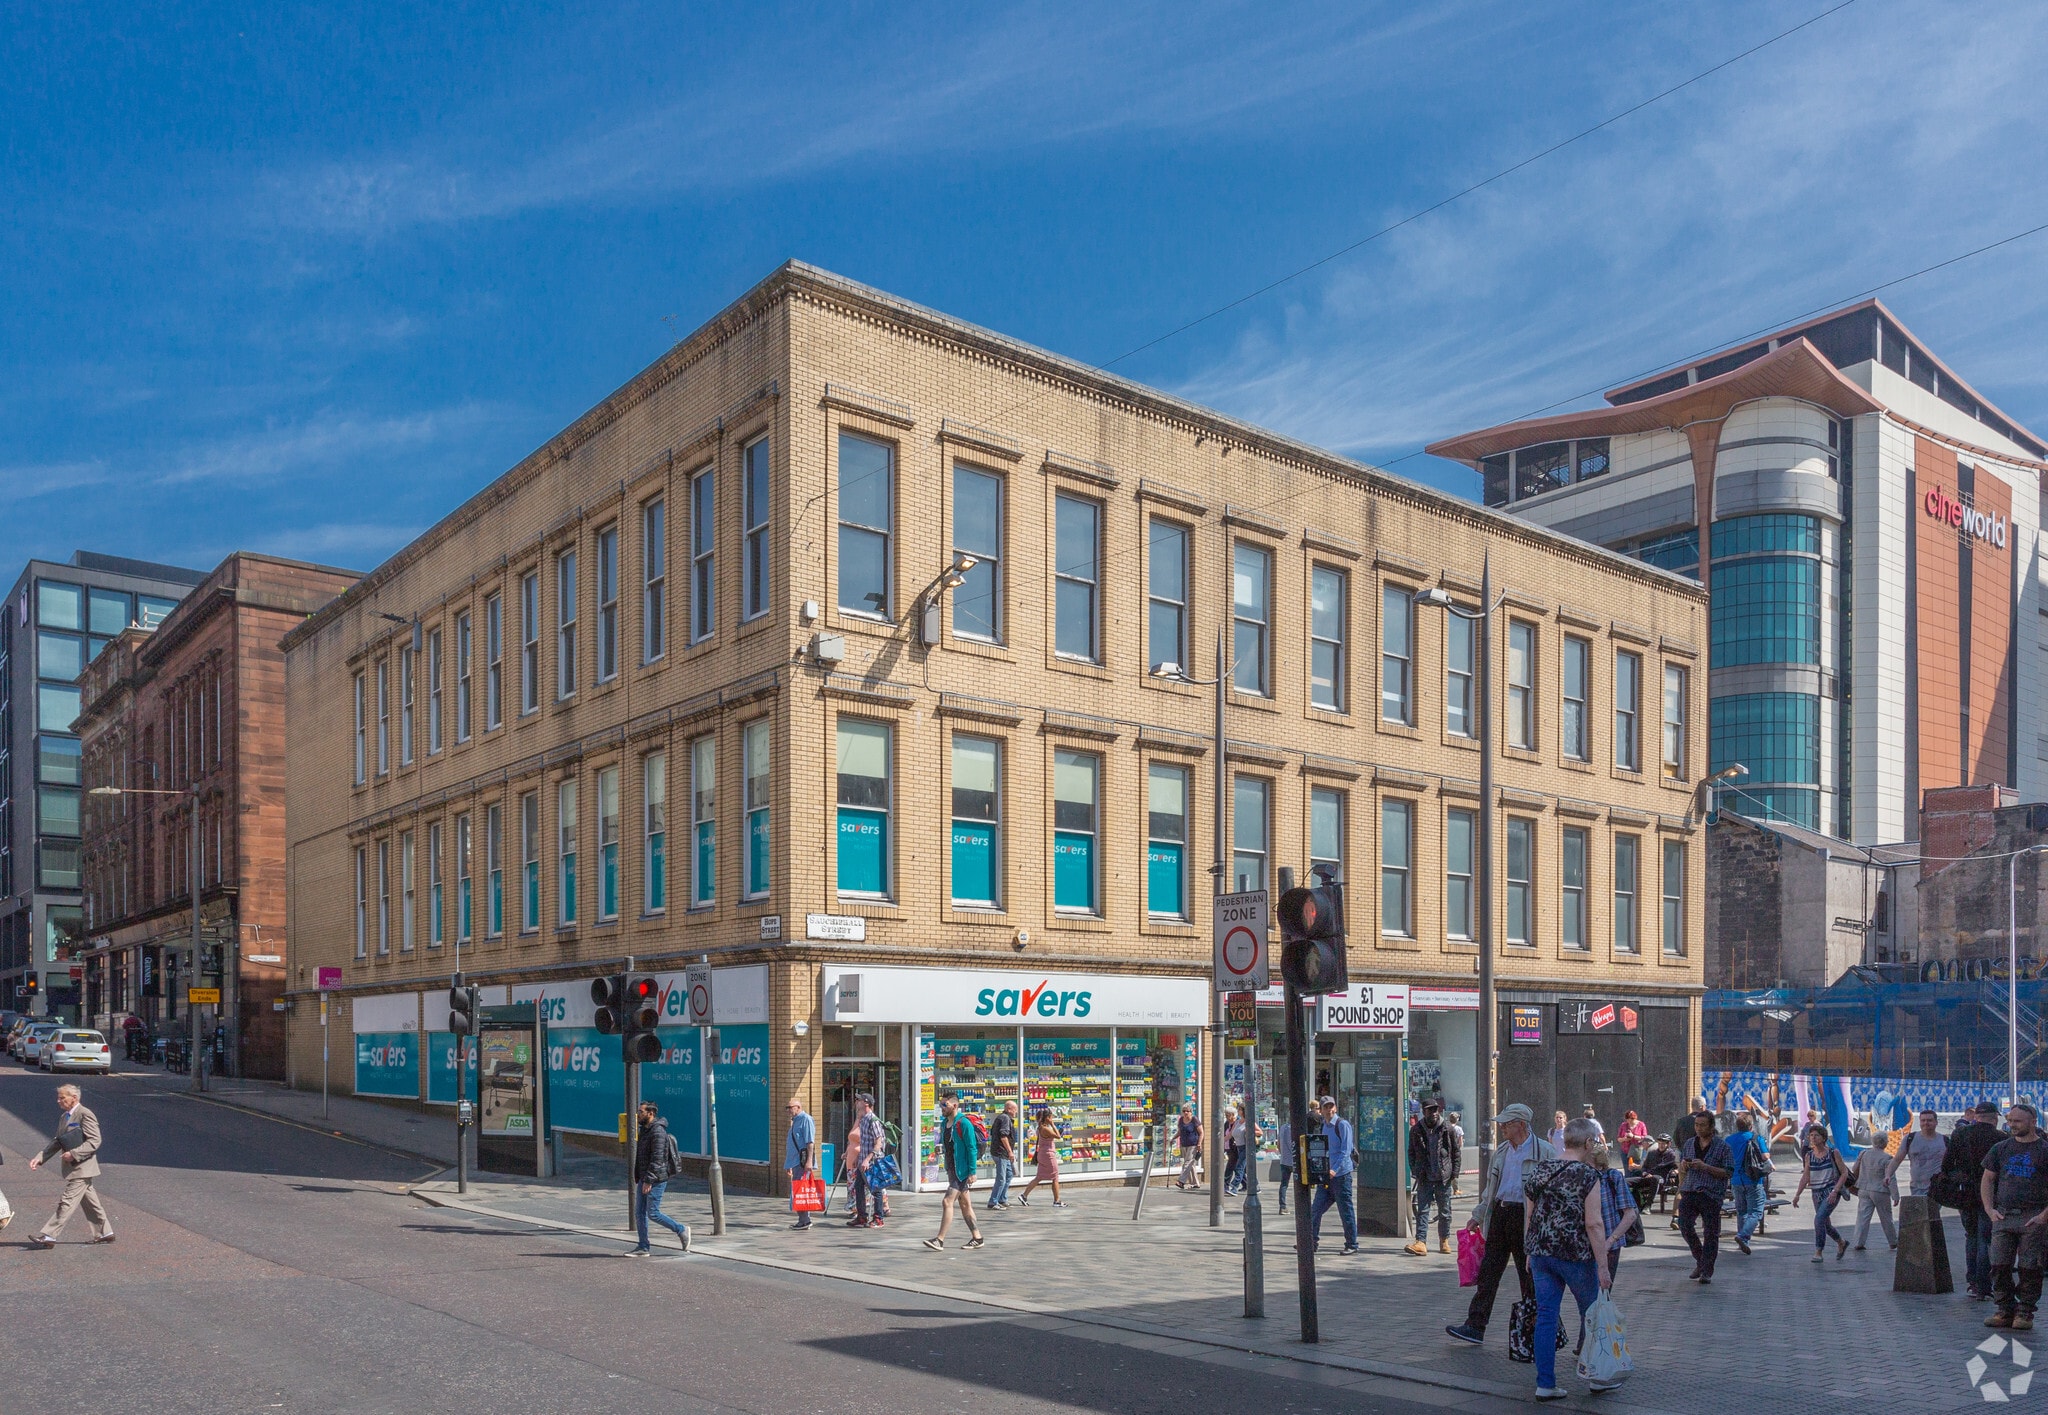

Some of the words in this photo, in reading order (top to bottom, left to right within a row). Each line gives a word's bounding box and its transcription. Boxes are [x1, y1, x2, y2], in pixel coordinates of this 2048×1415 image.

[1926, 485, 2005, 547] cineworld
[841, 821, 880, 835] savers
[954, 834, 989, 846] savers
[1055, 844, 1087, 855] savers
[1147, 853, 1177, 863] savers
[1216, 895, 1264, 907] PEDESTRIAN
[1223, 907, 1256, 922] ZONE
[809, 917, 862, 926] SAUCHIEHALL
[821, 926, 852, 934] STREET
[690, 973, 707, 982] ZONE
[1222, 979, 1231, 987] No
[975, 979, 1092, 1017] savers
[1230, 993, 1252, 1001] THINK
[1361, 987, 1374, 1004] £1
[1230, 1001, 1254, 1009] BEFORE
[1230, 1009, 1255, 1021] YOU
[1328, 1006, 1370, 1025] POUND
[1373, 1007, 1404, 1025] SHOP
[1593, 1011, 1614, 1026] Wraps
[1230, 1020, 1242, 1028] STEP
[1515, 1017, 1526, 1027] TO
[1528, 1017, 1539, 1028] LET
[940, 1043, 970, 1053] savers
[985, 1042, 1014, 1052] savers
[1029, 1041, 1056, 1051] savers
[1071, 1041, 1098, 1050] savers
[1116, 1041, 1139, 1050] avers
[370, 1040, 406, 1067] savers
[652, 1072, 671, 1080] HEALTH
[677, 1073, 692, 1082] HOME
[744, 1075, 761, 1083] HOME
[583, 1080, 600, 1089] BEAUTY
[665, 1087, 684, 1096] BEAUTY
[730, 1089, 751, 1098] BEAUTY
[509, 1119, 530, 1128] ASDA
